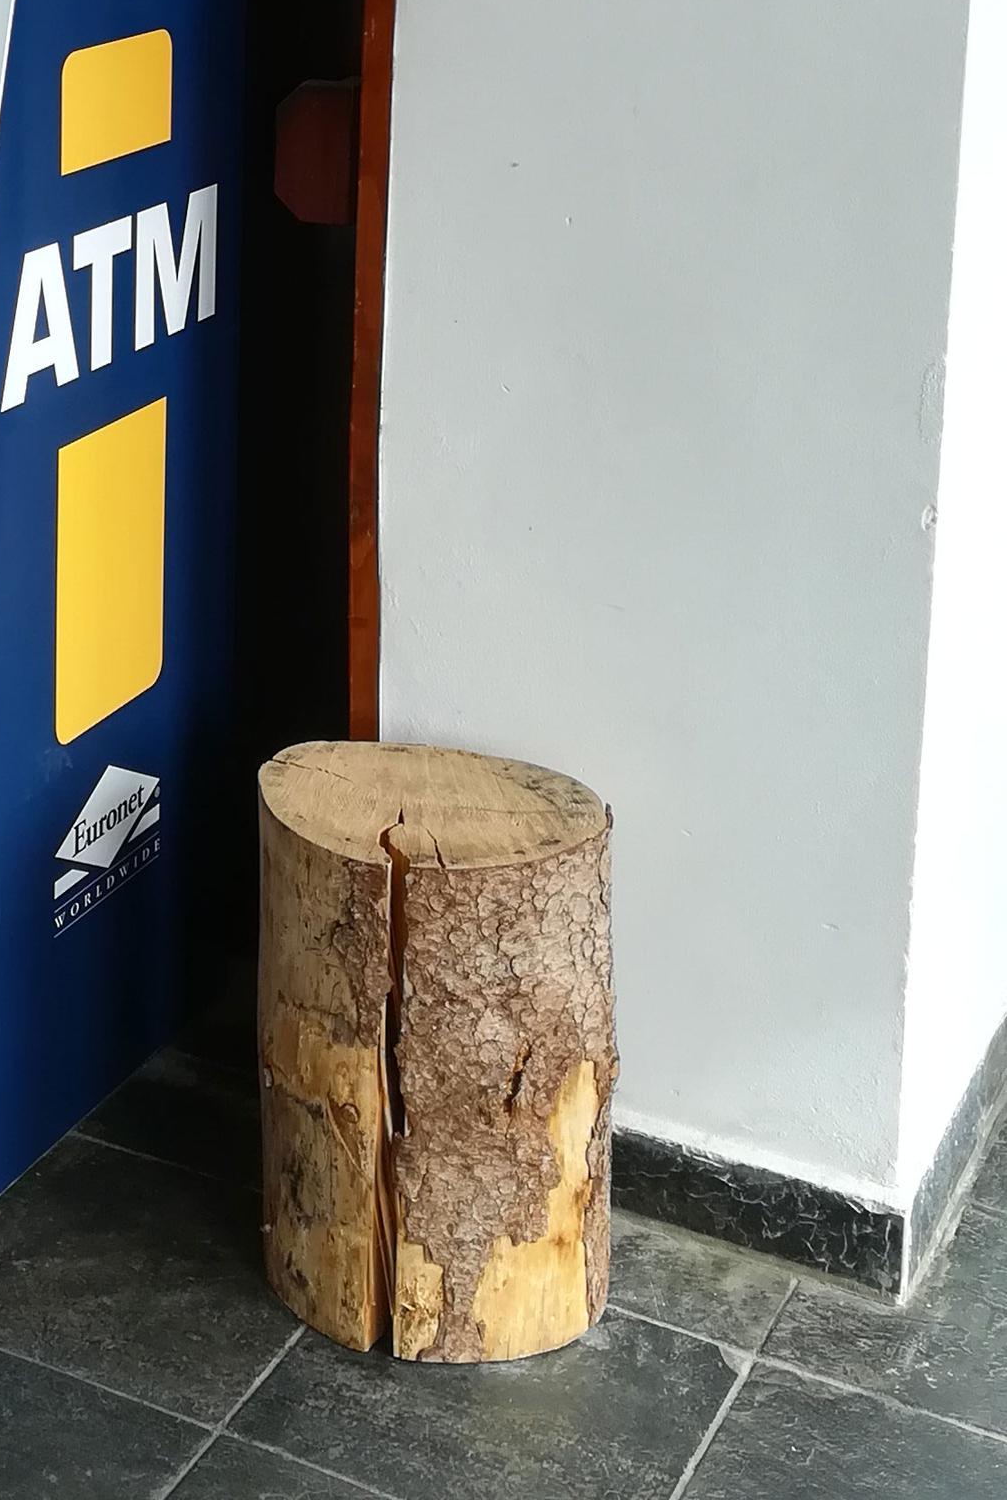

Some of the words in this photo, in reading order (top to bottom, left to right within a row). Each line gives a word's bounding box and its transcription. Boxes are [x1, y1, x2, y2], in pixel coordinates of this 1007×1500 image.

[0, 183, 219, 414] ATM
[72, 783, 145, 858] Euronet
[53, 837, 161, 929] WORLDWIDE
